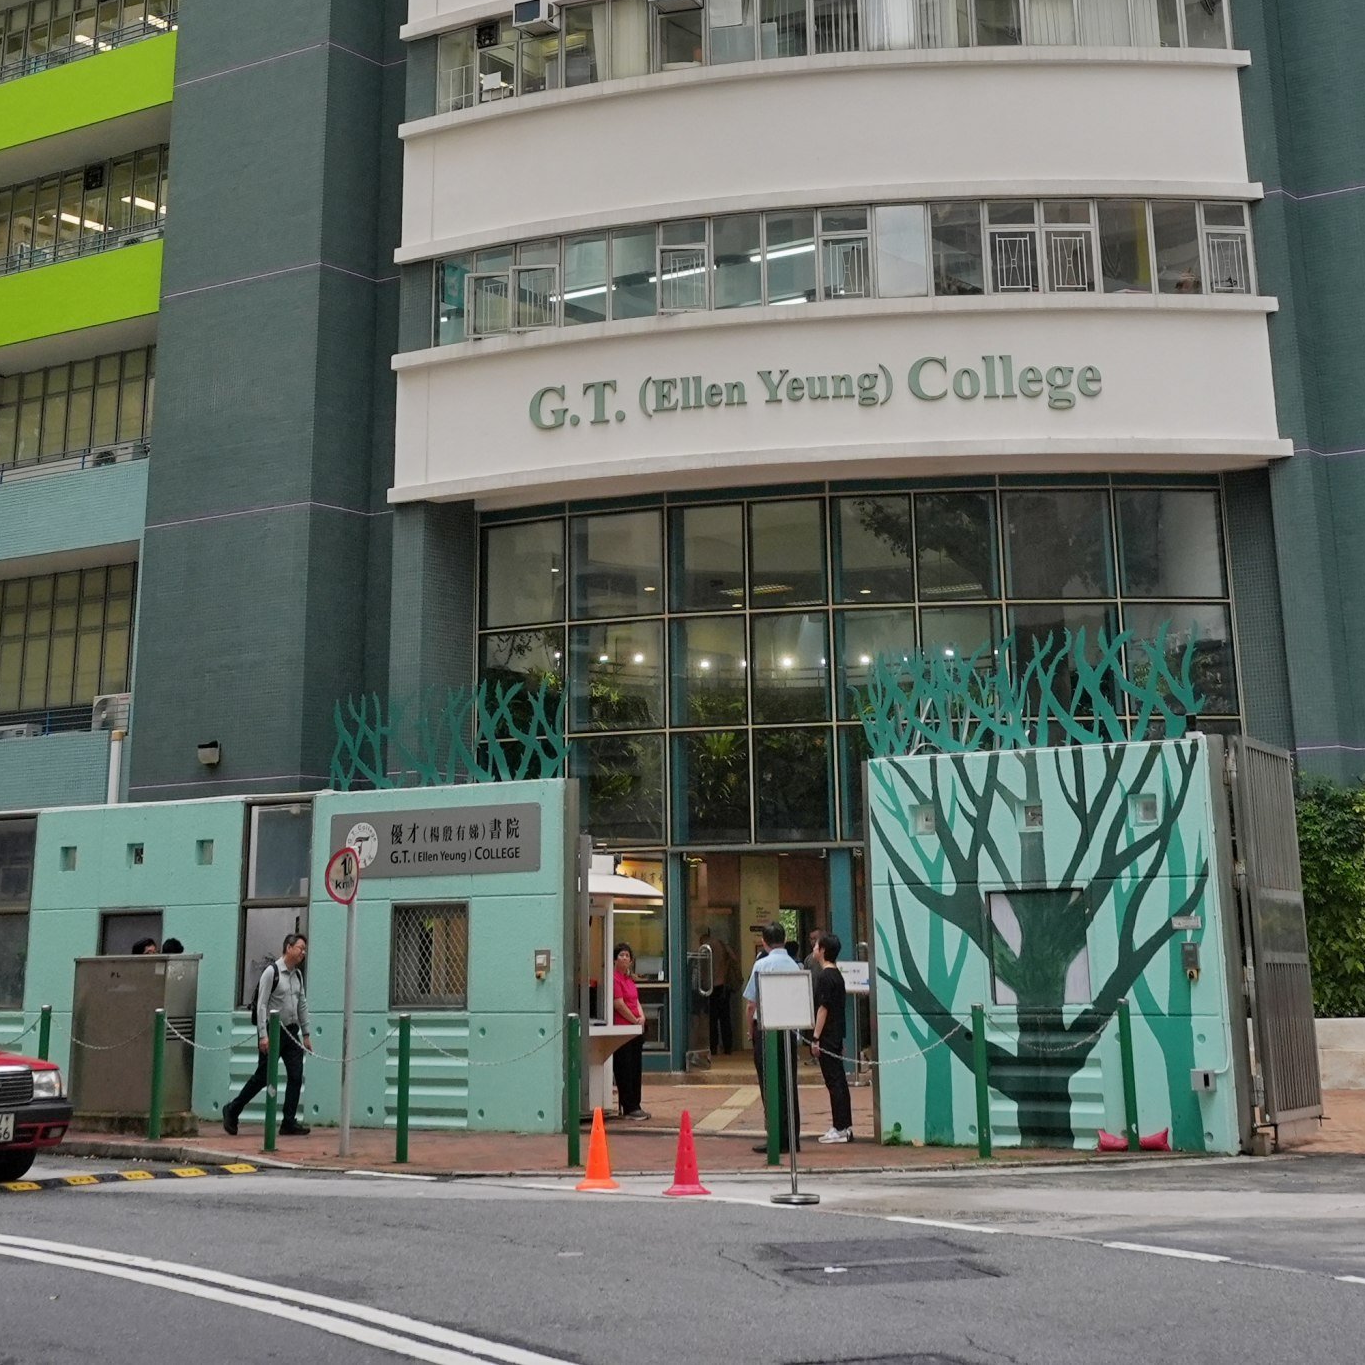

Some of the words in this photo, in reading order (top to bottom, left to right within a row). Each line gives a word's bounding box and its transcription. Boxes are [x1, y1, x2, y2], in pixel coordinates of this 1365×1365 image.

[528, 379, 628, 431] G.T.
[638, 375, 748, 418] (Ellen
[756, 363, 894, 407] Yeung)
[906, 354, 1104, 411] College
[390, 850, 411, 864] G.T.
[474, 846, 521, 861] COLLEGE
[341, 856, 353, 876] 10
